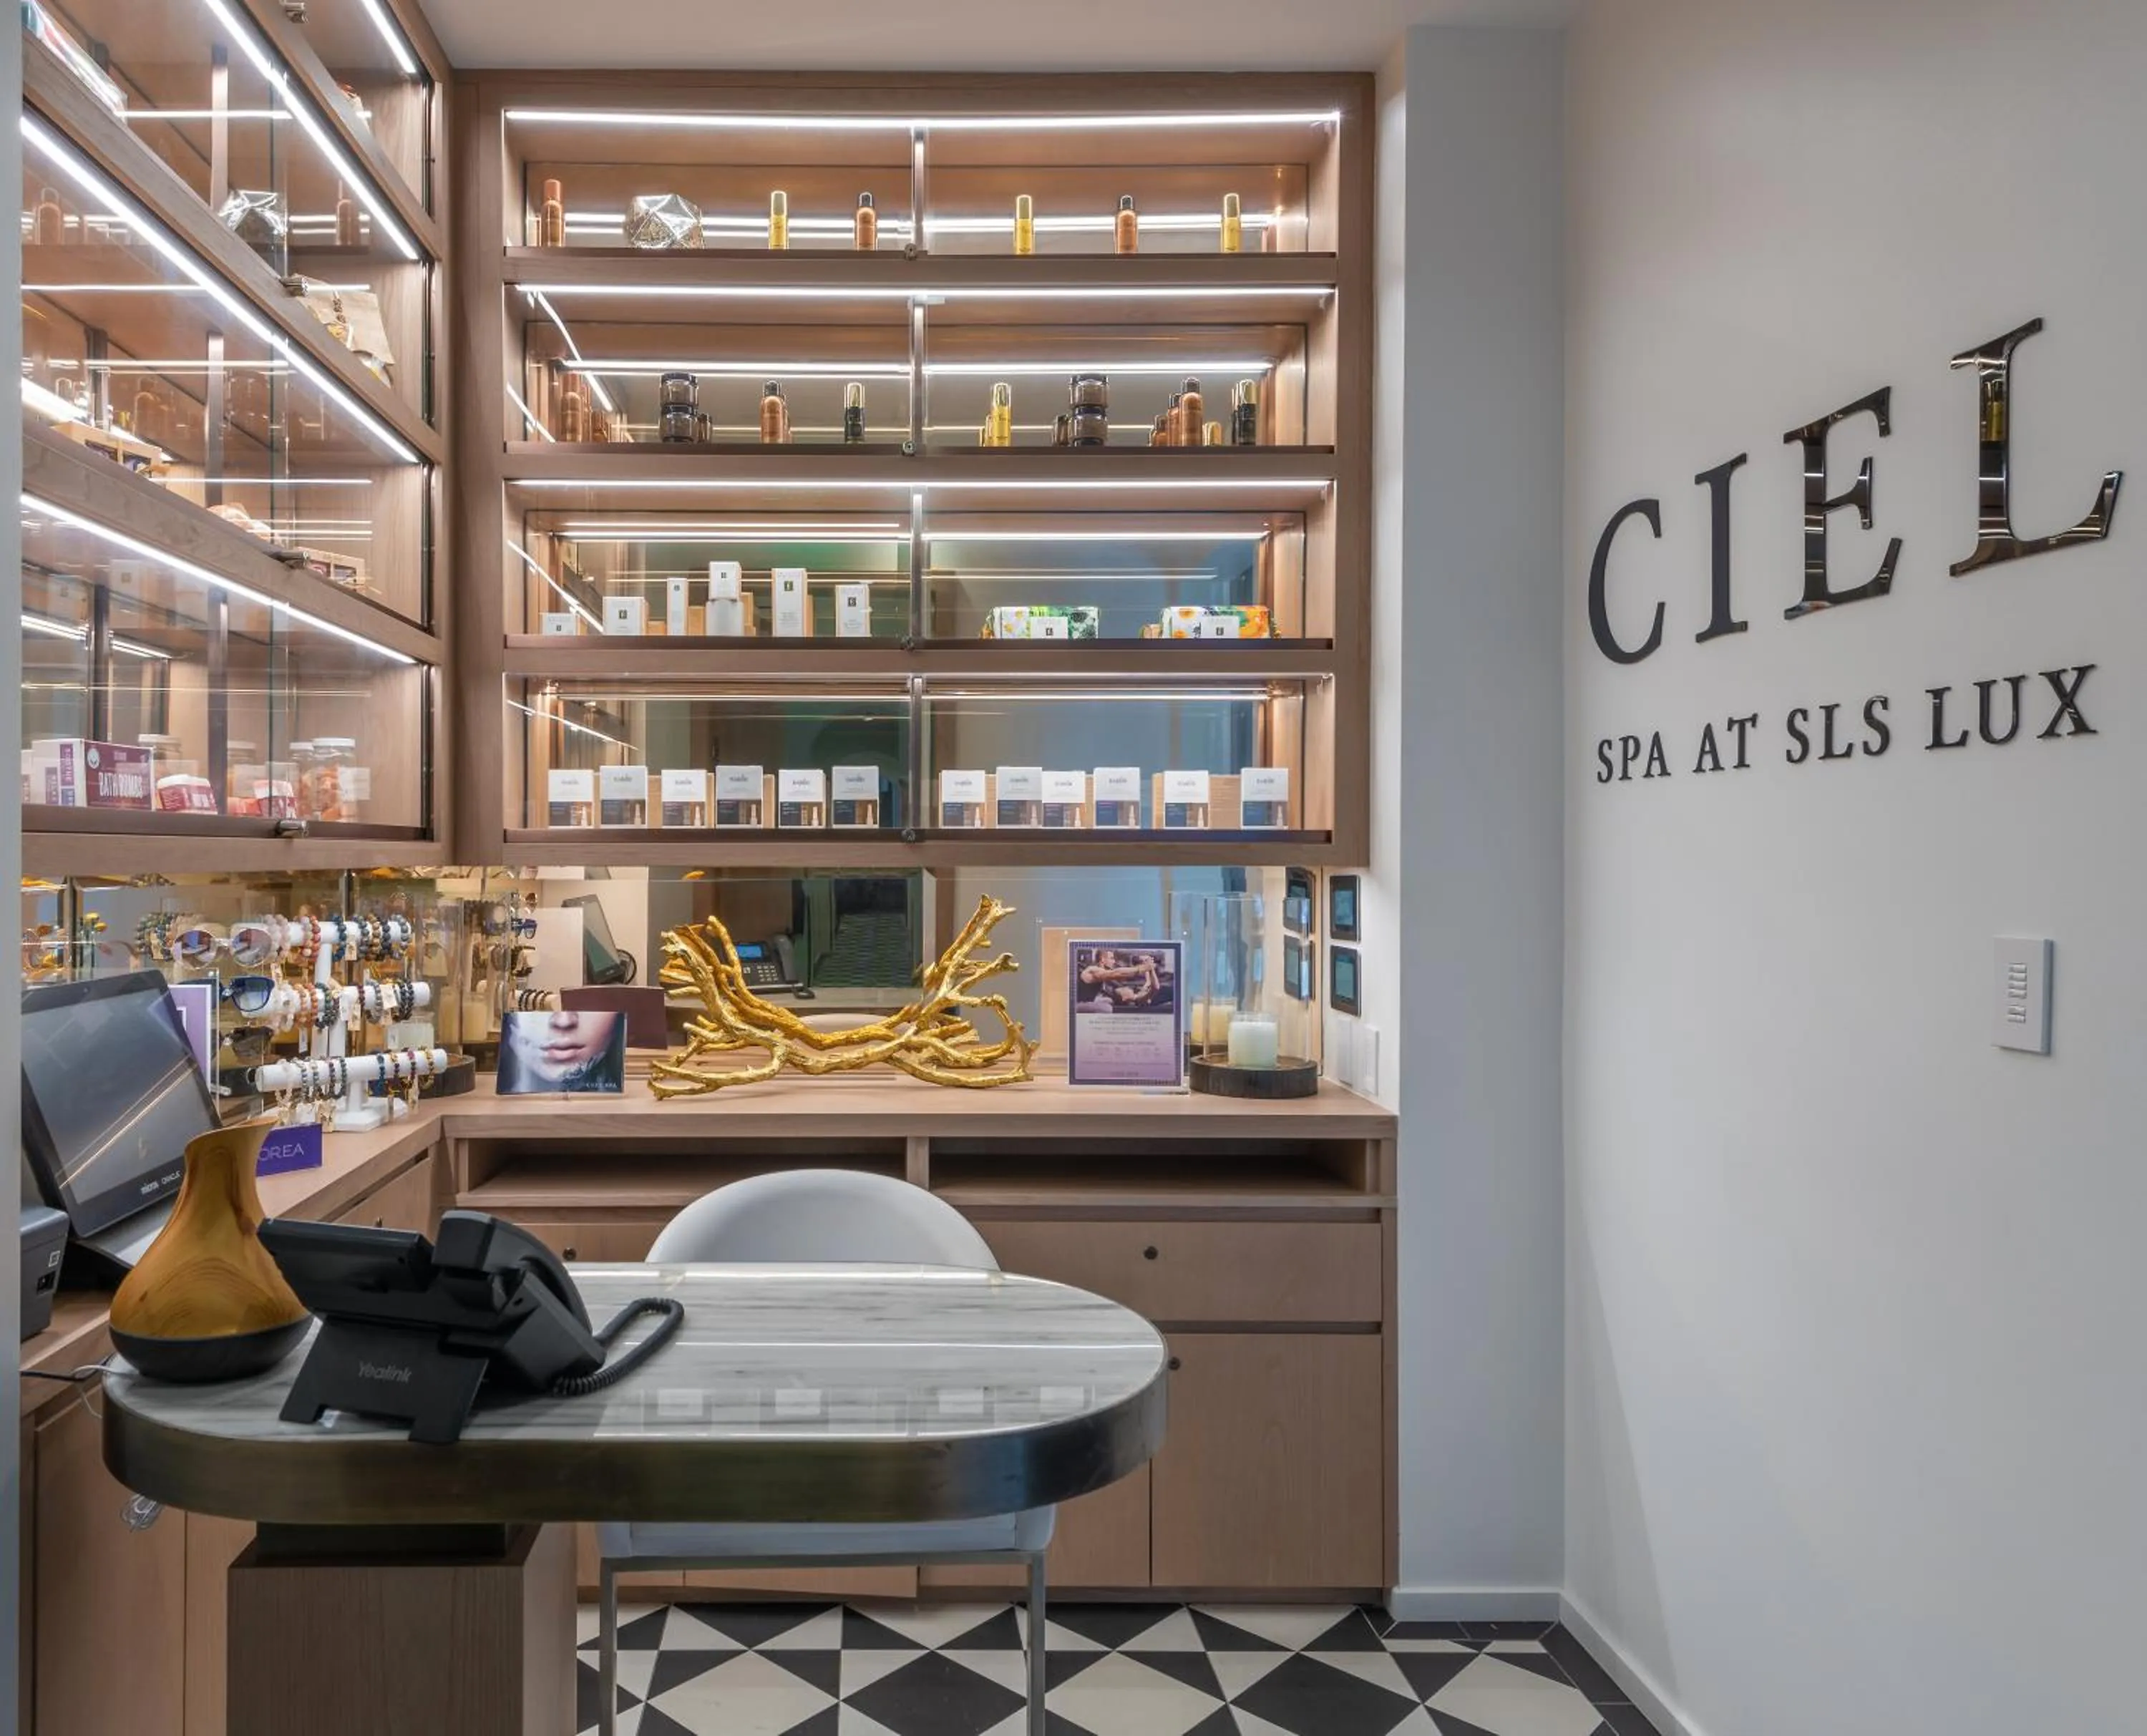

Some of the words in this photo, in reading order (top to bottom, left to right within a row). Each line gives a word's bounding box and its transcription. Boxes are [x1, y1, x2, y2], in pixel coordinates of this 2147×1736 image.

[1588, 317, 2124, 665] CIEL
[1597, 730, 1672, 784] SPA
[1693, 713, 1758, 773] AT
[1786, 695, 1892, 764] SLS
[1924, 664, 2098, 750] LUX
[359, 1360, 412, 1384] Yealink
